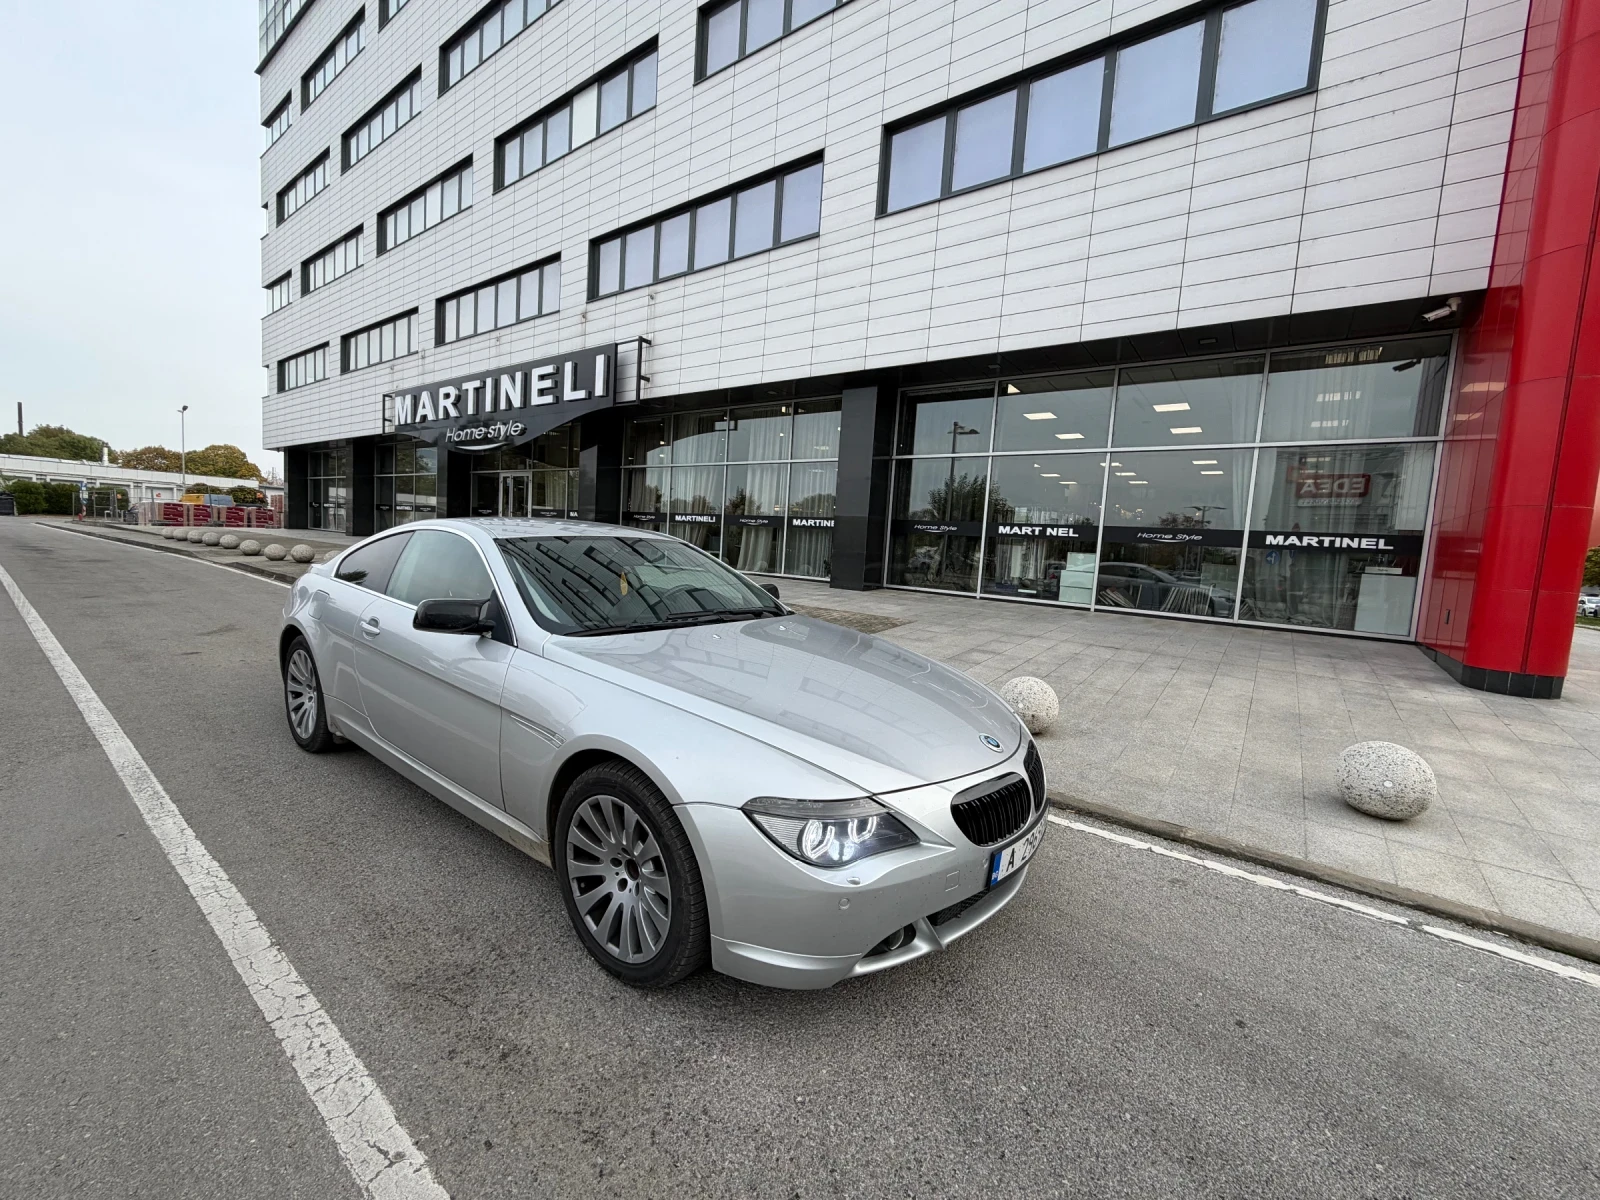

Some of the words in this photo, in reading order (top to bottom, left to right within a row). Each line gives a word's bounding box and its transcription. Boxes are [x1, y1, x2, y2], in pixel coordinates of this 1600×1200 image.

[395, 354, 609, 425] MARTINELI
[445, 426, 485, 442] Home
[1175, 533, 1203, 541] Style
[1265, 535, 1394, 549] MARTINEL
[1006, 847, 1015, 872] A
